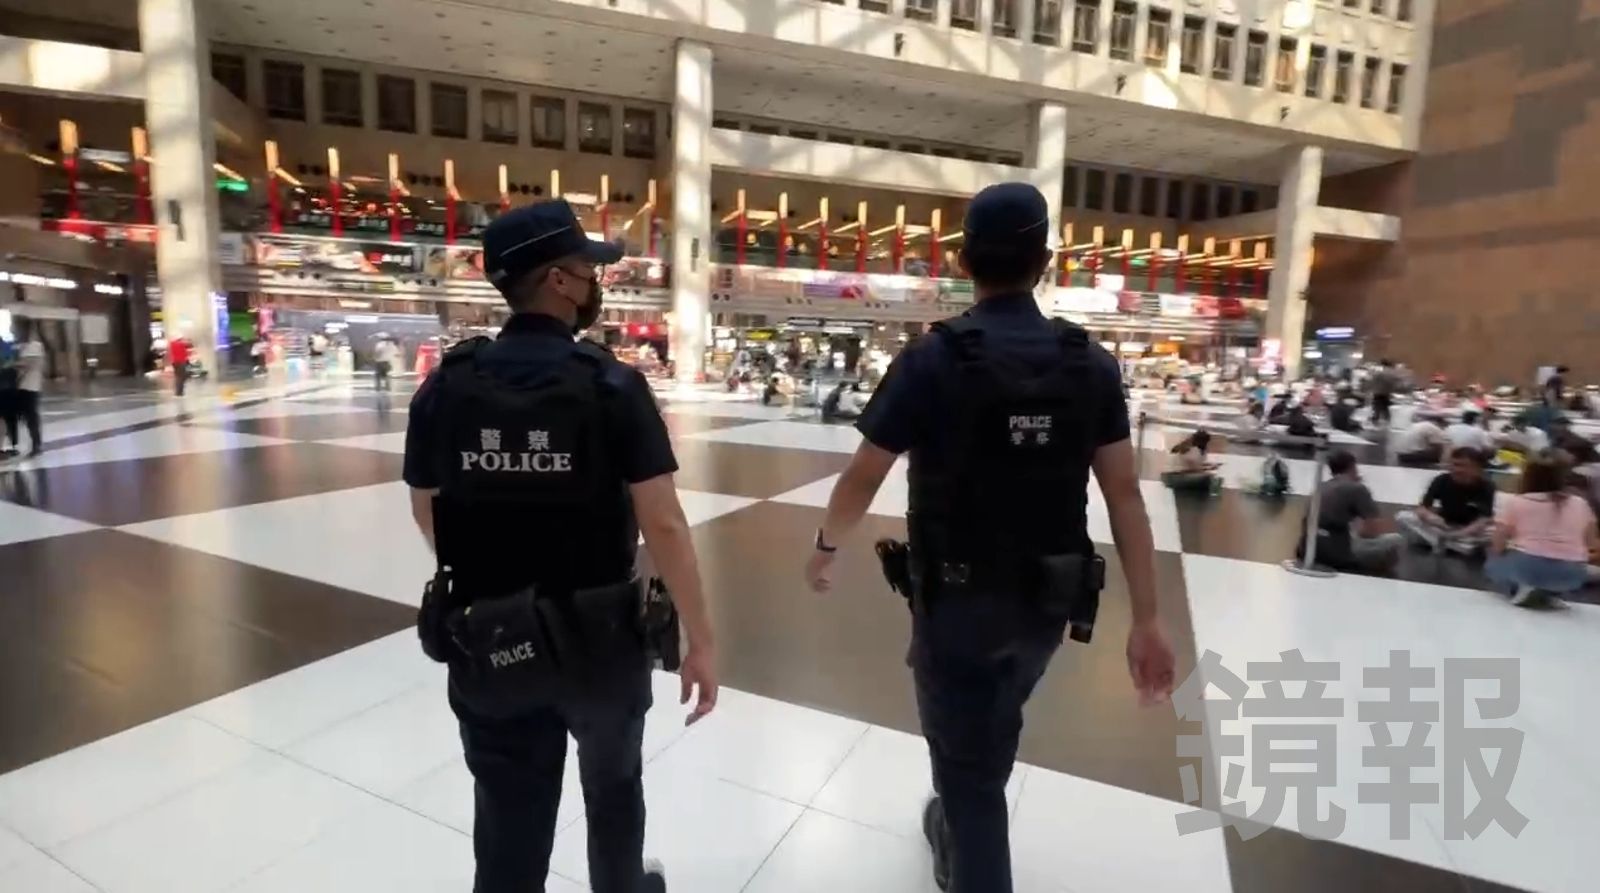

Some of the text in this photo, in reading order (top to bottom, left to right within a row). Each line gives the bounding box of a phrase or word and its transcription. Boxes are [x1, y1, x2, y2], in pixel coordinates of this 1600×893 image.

[1009, 415, 1052, 429] POLICE
[480, 428, 550, 451] 警察
[460, 451, 572, 472] POLICE
[489, 641, 536, 669] POLICE
